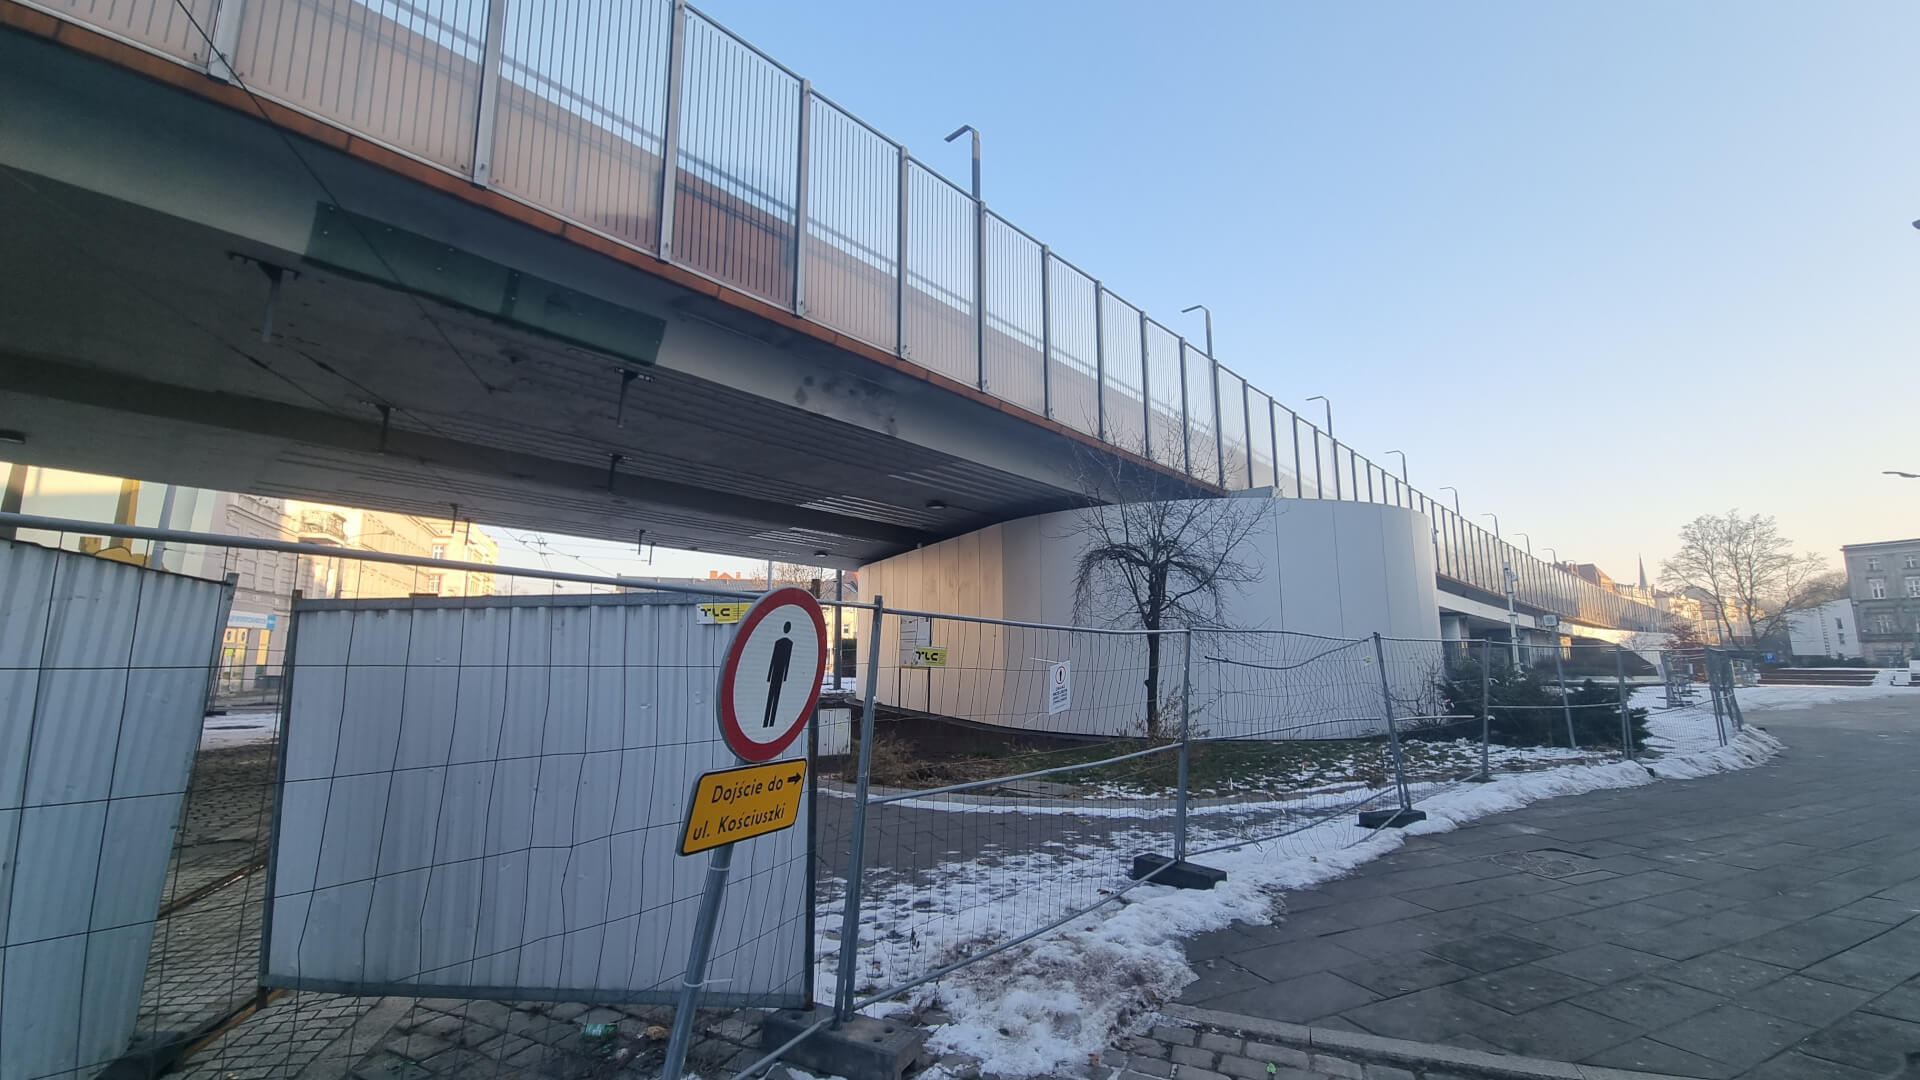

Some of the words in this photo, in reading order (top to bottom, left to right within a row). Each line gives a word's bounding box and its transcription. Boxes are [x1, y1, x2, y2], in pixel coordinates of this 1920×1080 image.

[700, 608, 730, 617] TLC
[915, 651, 938, 661] TLC
[711, 778, 763, 804] Dojście
[767, 776, 783, 792] do
[693, 820, 710, 840] ul.
[718, 802, 786, 834] Kościuszki
